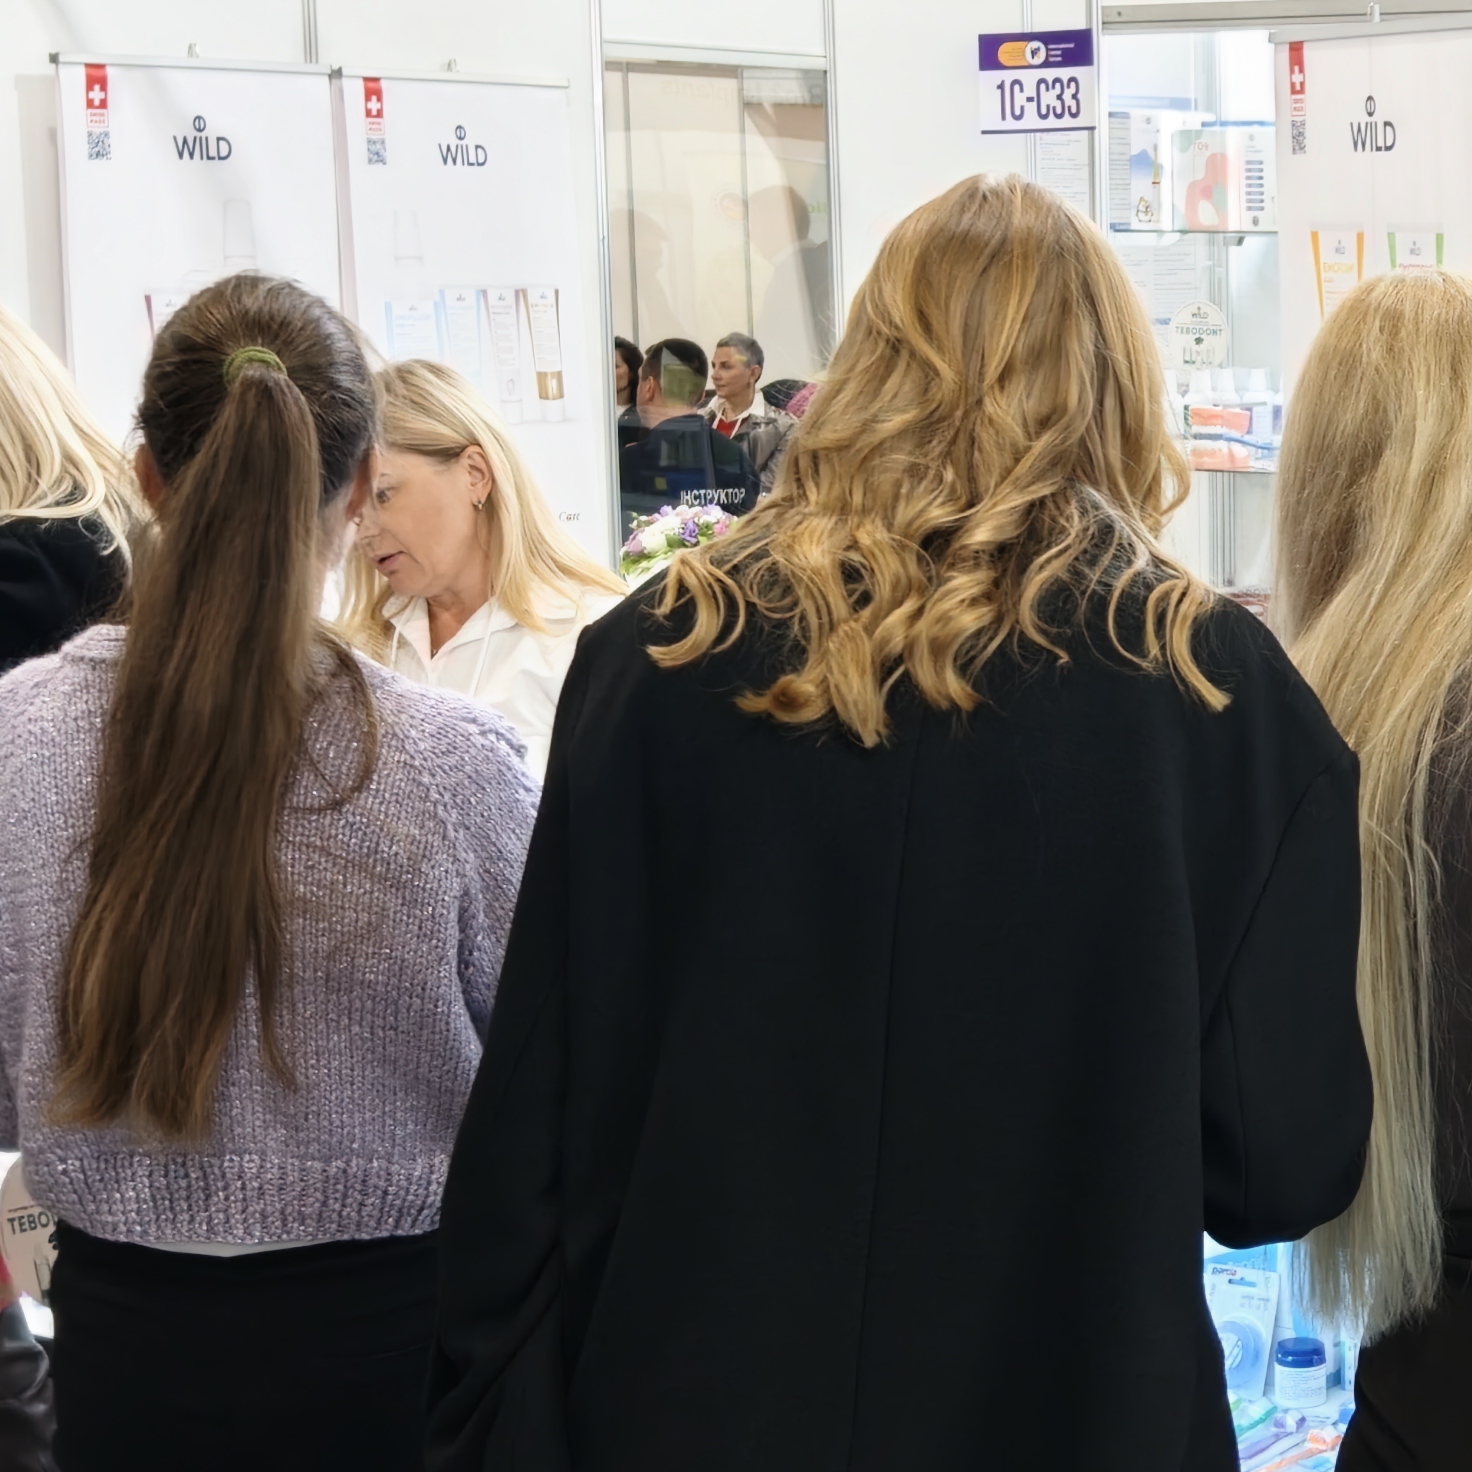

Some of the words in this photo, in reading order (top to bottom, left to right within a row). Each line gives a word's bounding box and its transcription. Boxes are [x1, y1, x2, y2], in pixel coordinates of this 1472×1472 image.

[996, 76, 1081, 121] 1C-C33
[173, 135, 232, 160] WILD
[1350, 121, 1396, 152] WILD
[438, 143, 488, 167] WILD
[1175, 326, 1223, 337] TEBODONT
